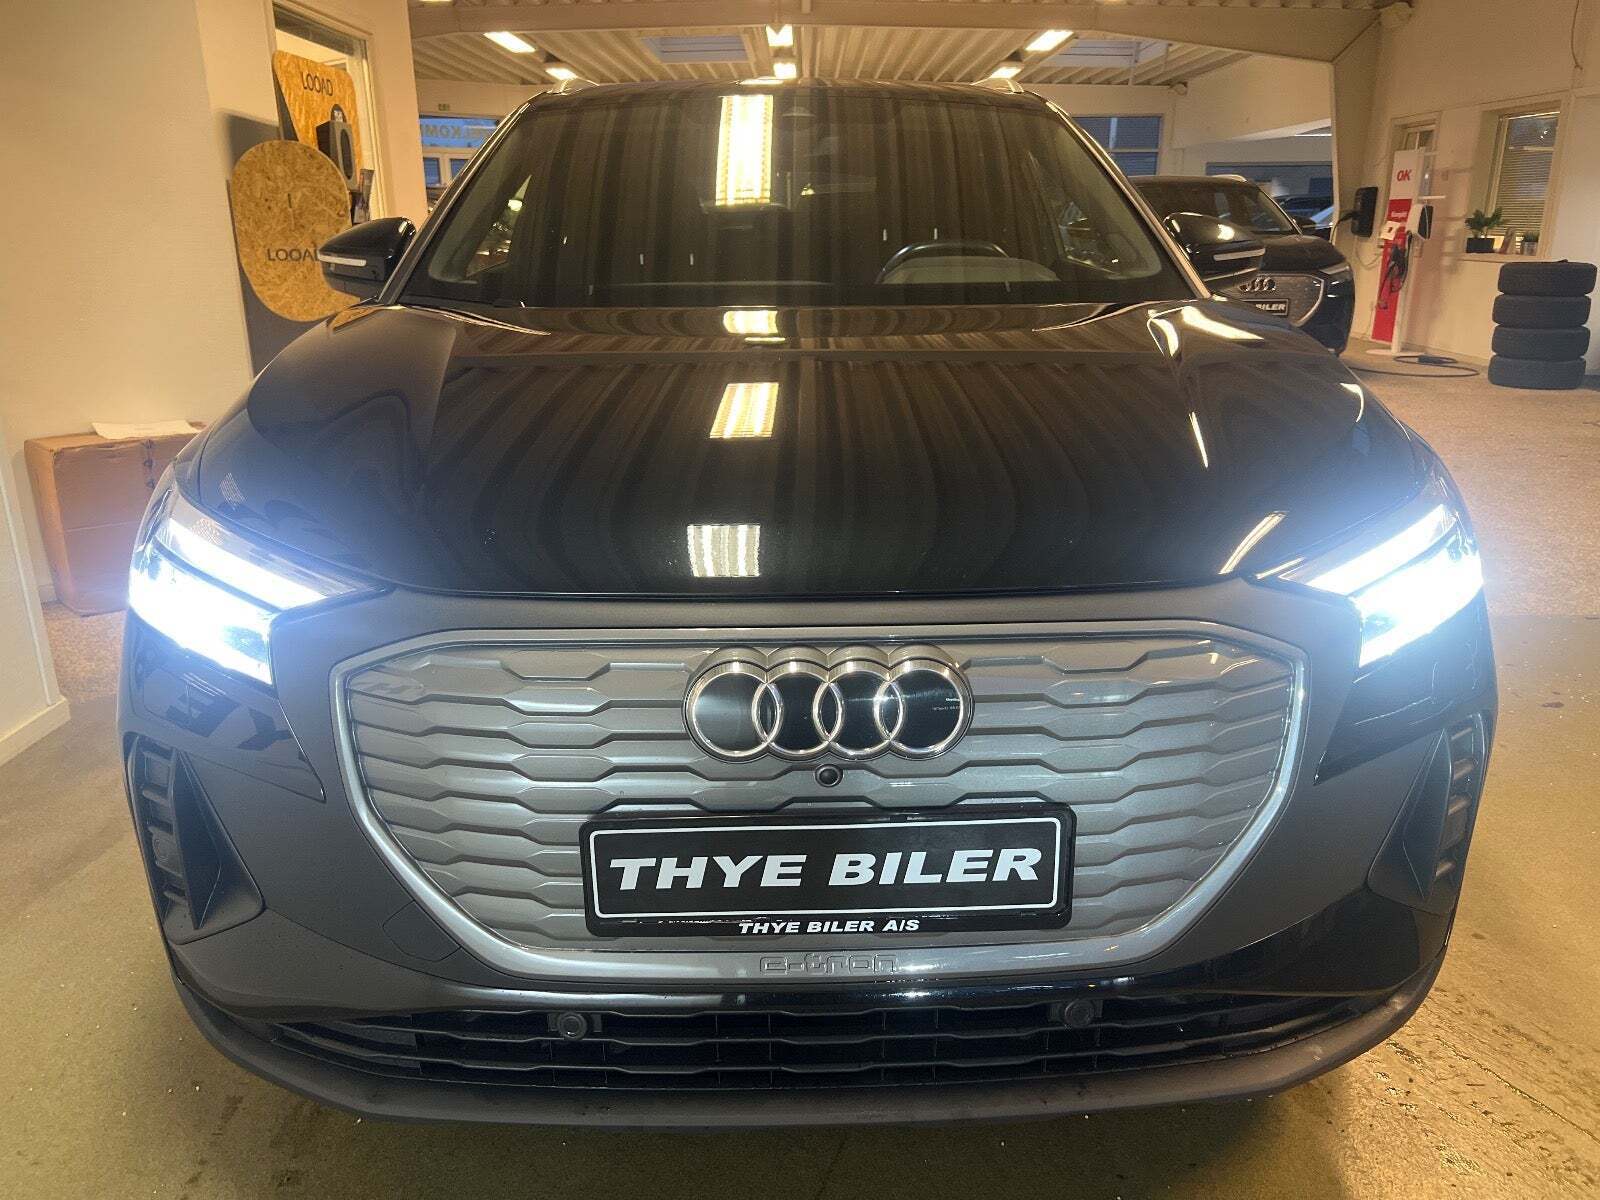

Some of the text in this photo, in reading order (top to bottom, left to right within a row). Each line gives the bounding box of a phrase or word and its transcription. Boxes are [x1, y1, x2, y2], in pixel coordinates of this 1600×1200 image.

[301, 71, 334, 96] LOOAD
[1397, 169, 1412, 182] OK
[609, 848, 1041, 890] THYE BILER
[738, 919, 920, 934] THYE BILER A/S
[760, 953, 897, 976] e-tron
